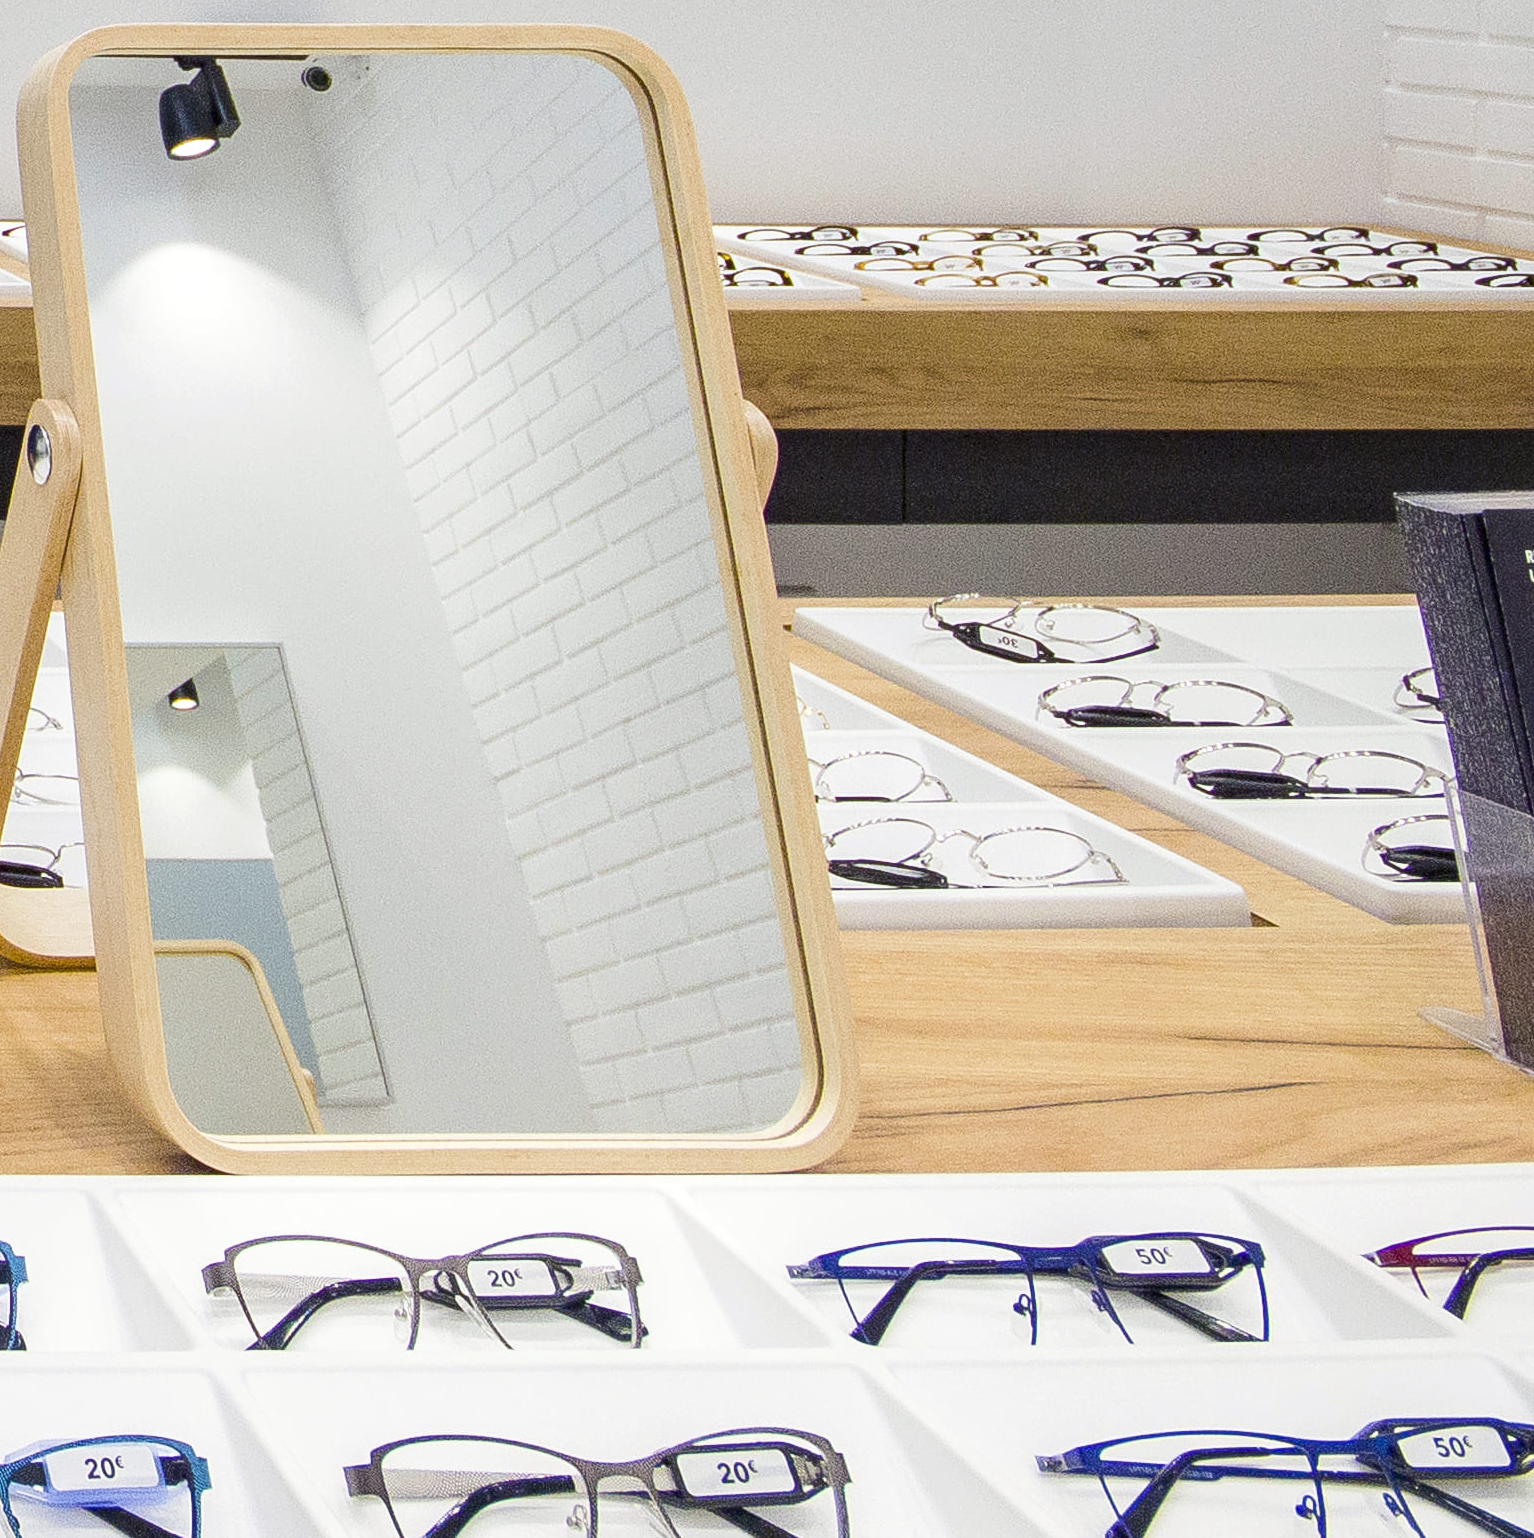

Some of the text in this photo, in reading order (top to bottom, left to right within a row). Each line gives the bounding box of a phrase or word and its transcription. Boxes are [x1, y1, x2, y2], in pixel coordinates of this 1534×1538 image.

[1135, 1247, 1171, 1265] 50€
[487, 1269, 522, 1288] 20€
[1432, 1435, 1472, 1458] 50€
[84, 1455, 124, 1480] 20€
[717, 1460, 758, 1485] 20€
